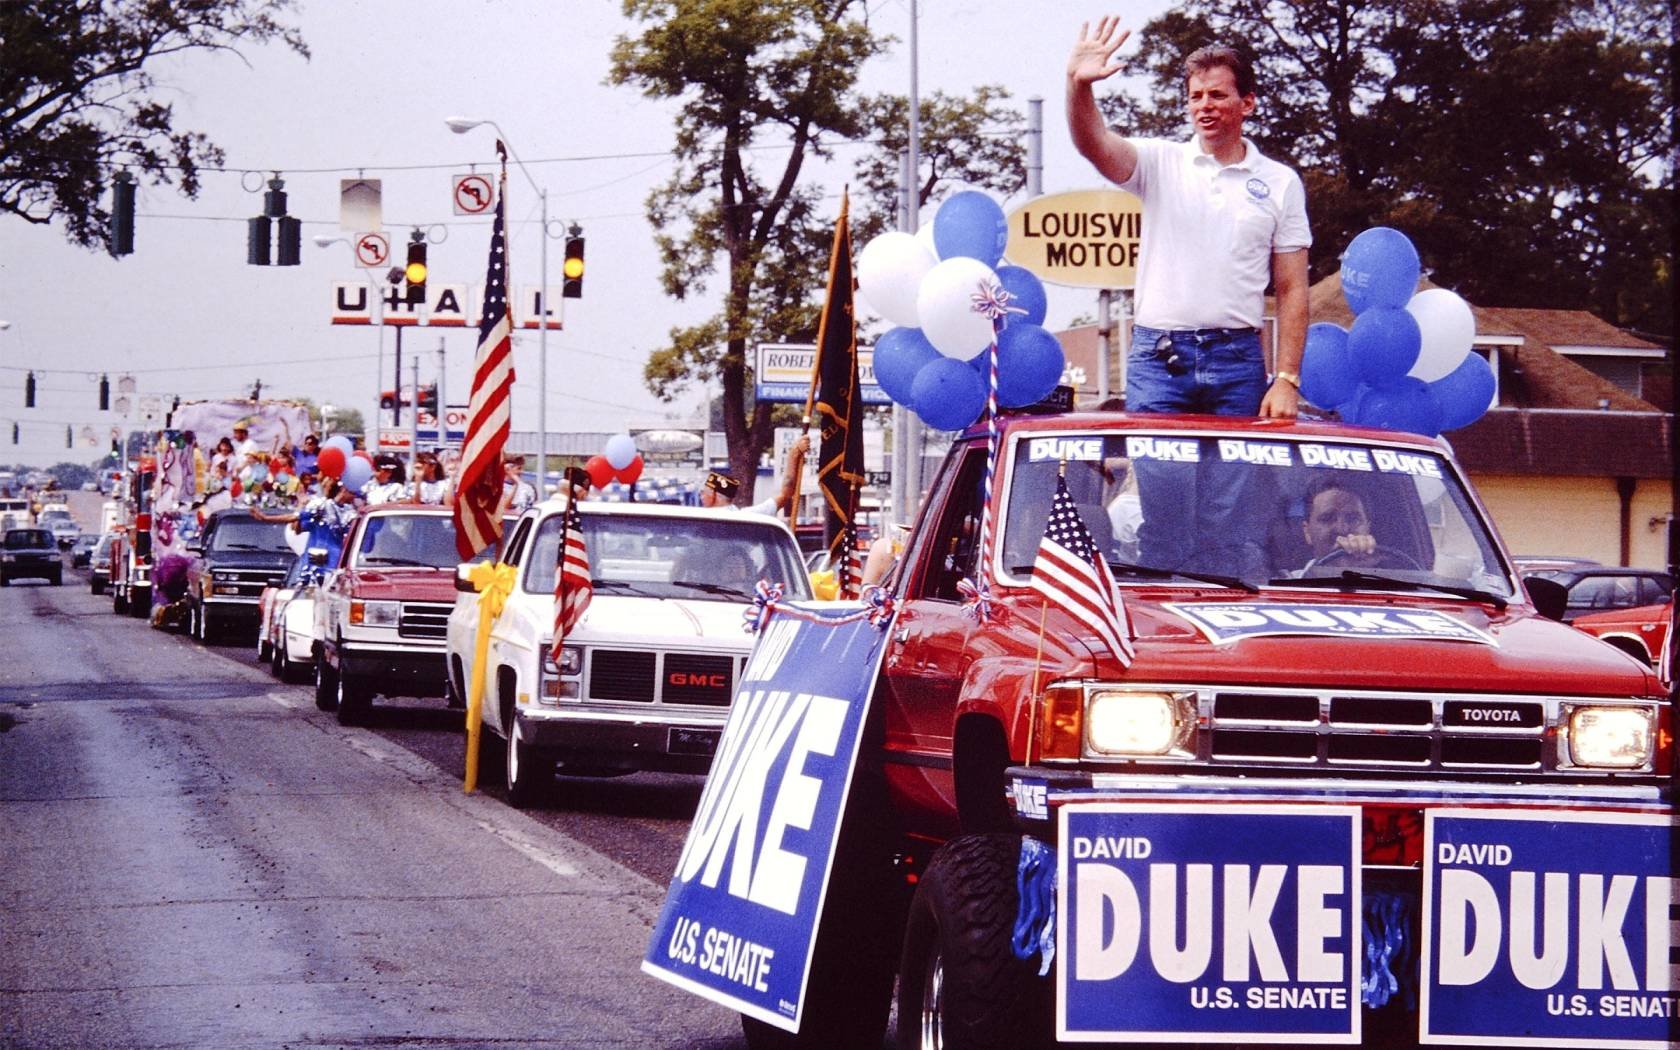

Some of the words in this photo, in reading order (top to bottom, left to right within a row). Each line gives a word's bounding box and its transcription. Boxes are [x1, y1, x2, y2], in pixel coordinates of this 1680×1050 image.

[1030, 438, 1103, 460] DUKE
[1127, 438, 1200, 461] DUKE
[1218, 441, 1291, 466] DUKE
[1299, 445, 1373, 471] DUKE
[1372, 449, 1443, 479] DUKE
[1190, 609, 1472, 634] DUKE
[670, 673, 726, 687] GMC
[1462, 709, 1521, 721] TOYOTA
[1073, 837, 1151, 859] DAVID
[1438, 843, 1513, 866] DAVID
[1076, 863, 1344, 983] DUKE
[1438, 868, 1680, 992] DUKE
[668, 916, 701, 965] U.S.
[699, 927, 774, 993] SENATE
[1191, 987, 1239, 1009] U.S.
[1246, 988, 1347, 1009] SENATE
[1547, 994, 1593, 1016] U.S.
